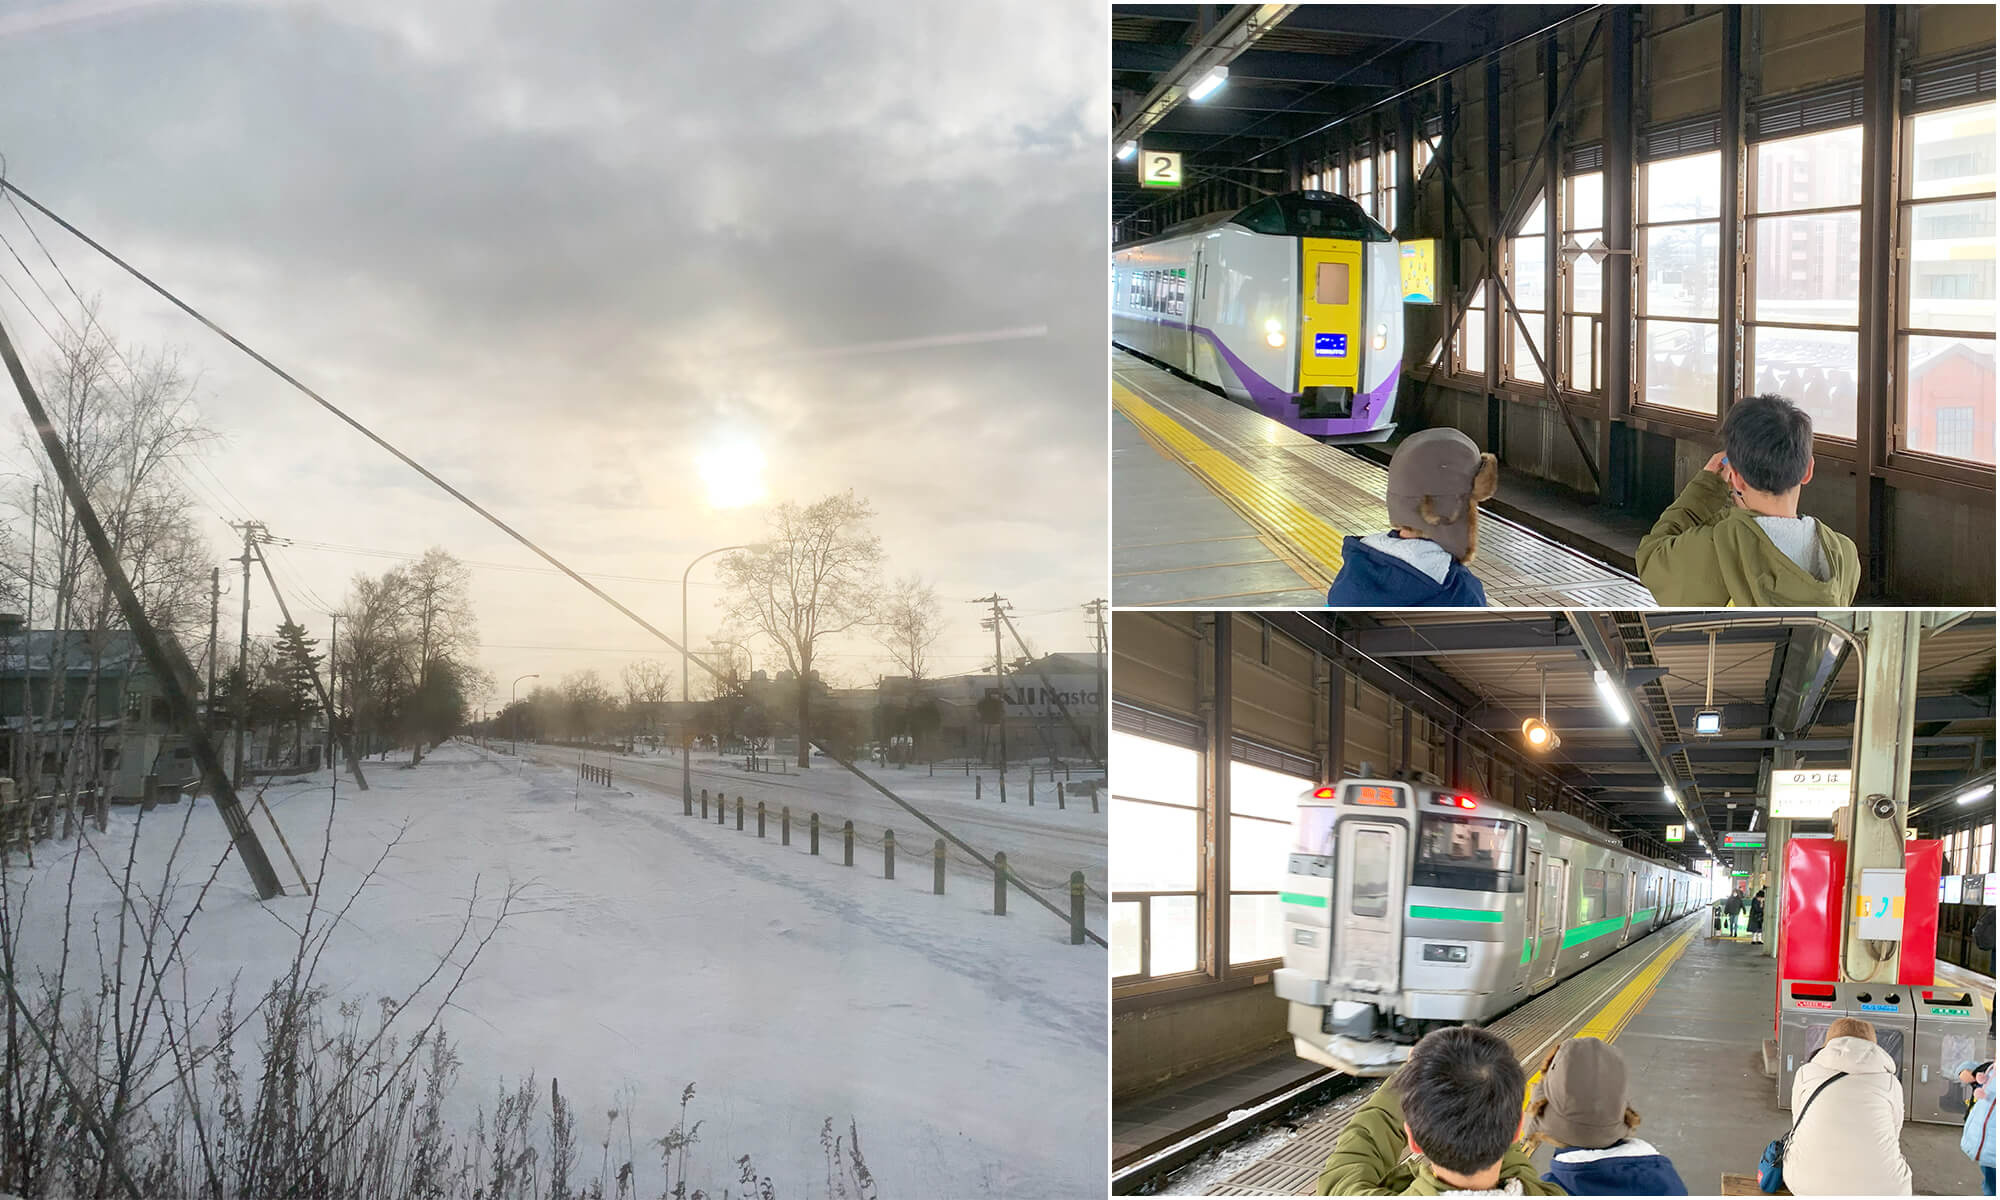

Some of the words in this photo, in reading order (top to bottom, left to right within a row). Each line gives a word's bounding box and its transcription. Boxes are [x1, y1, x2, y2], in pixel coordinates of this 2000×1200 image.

[1154, 157, 1172, 177] 2
[1040, 687, 1100, 705] Nasta
[1672, 827, 1677, 838] 1
